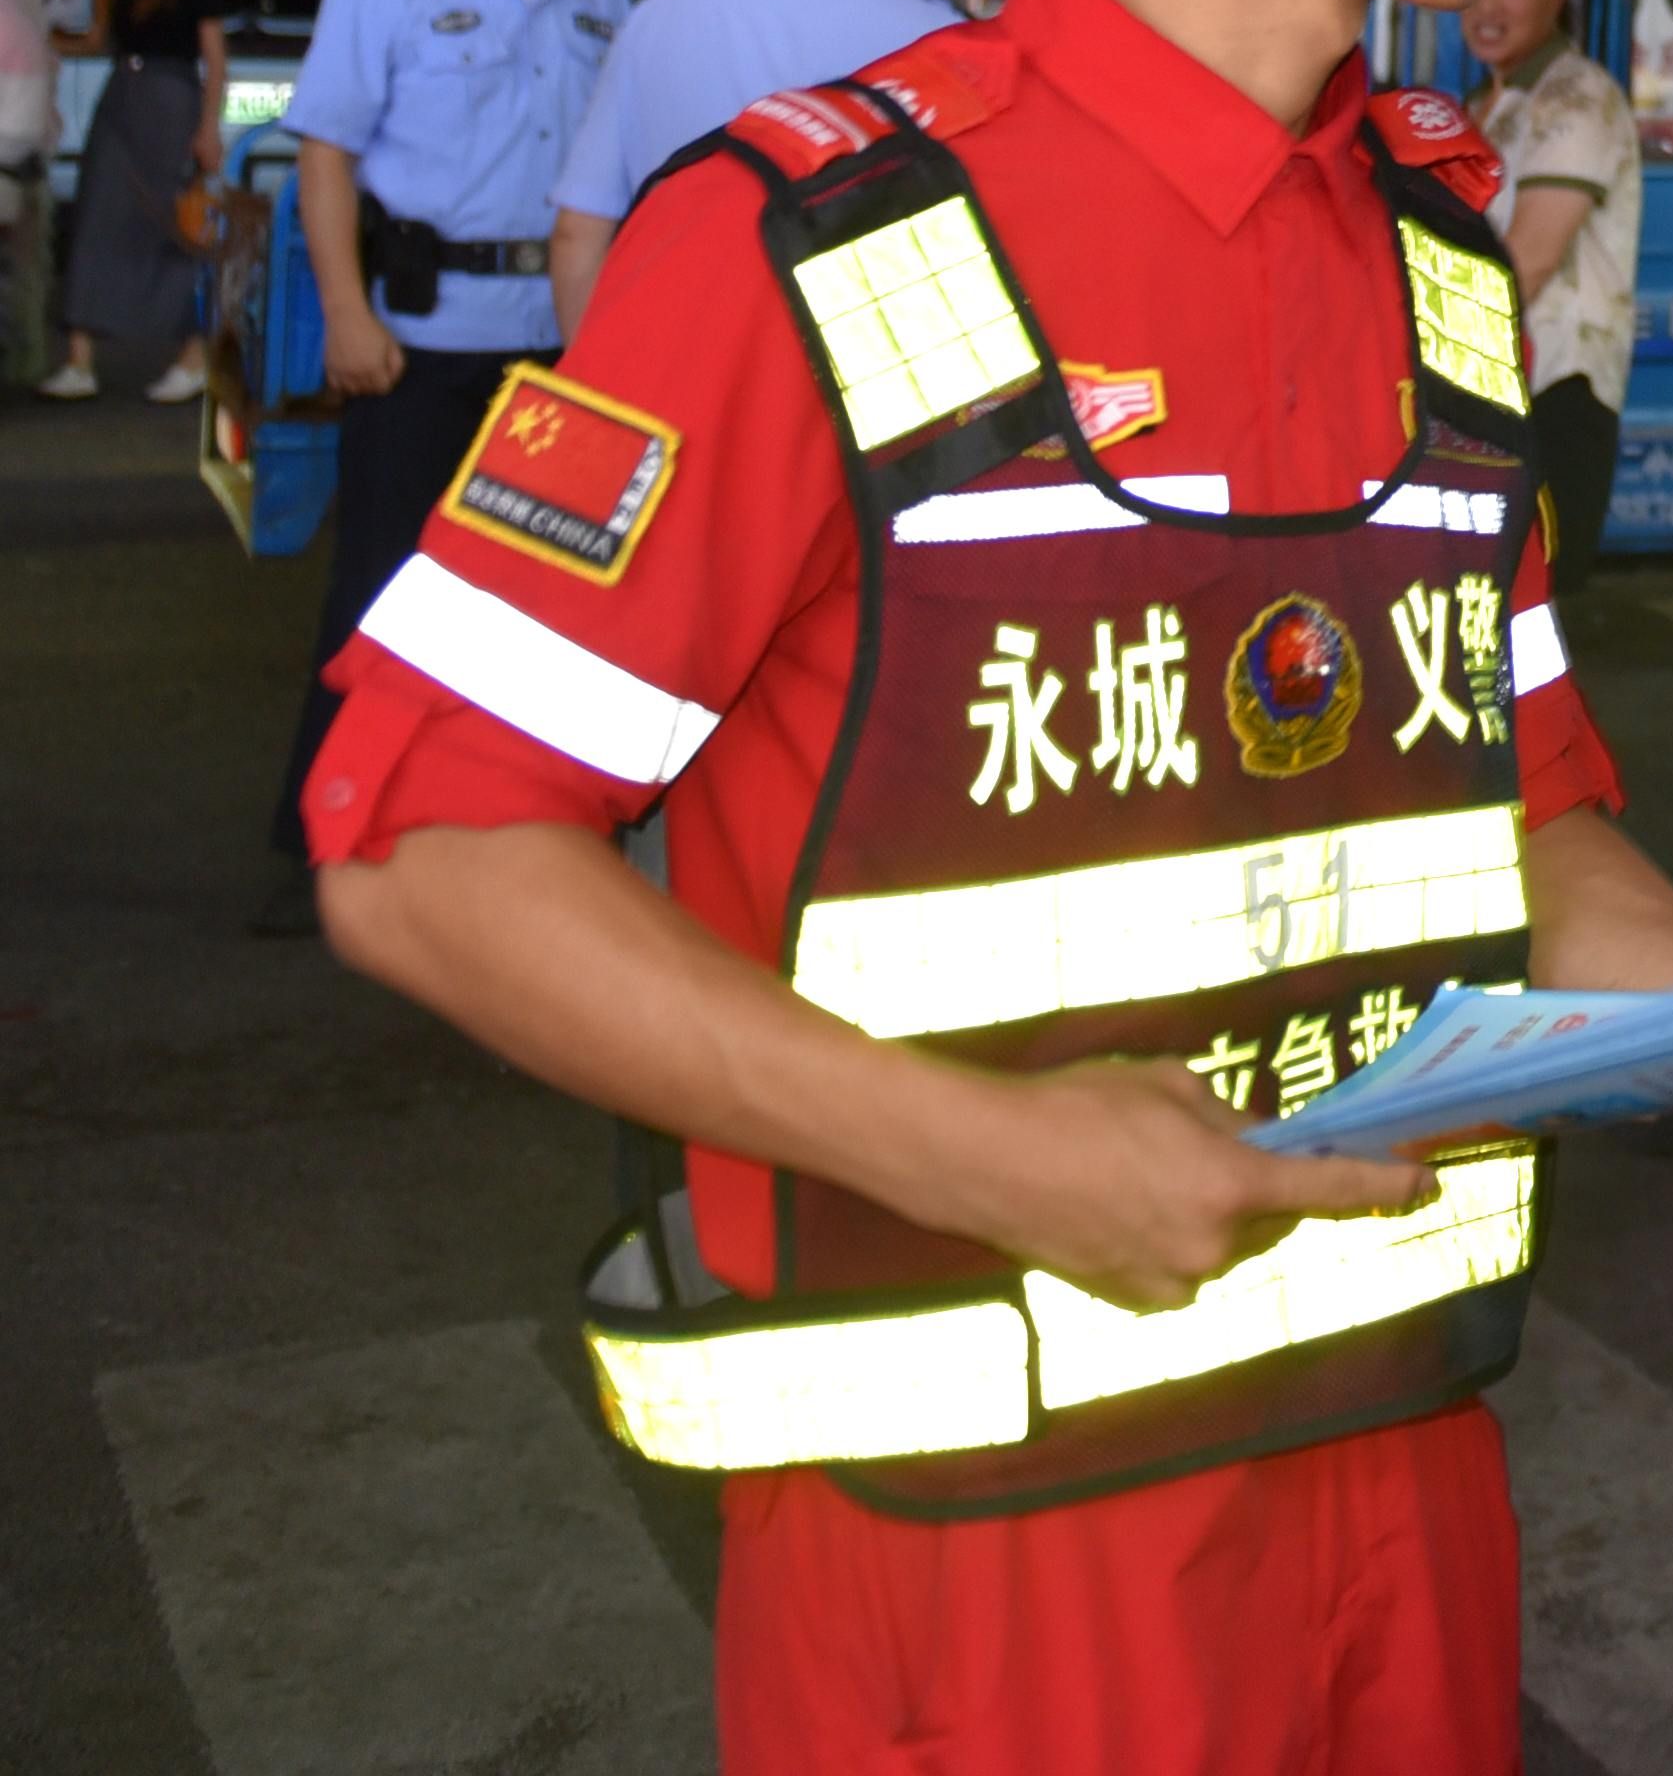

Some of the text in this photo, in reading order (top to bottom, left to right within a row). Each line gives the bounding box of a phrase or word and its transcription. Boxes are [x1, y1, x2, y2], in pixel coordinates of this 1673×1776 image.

[528, 505, 614, 562] CHINA
[968, 572, 1509, 813] 永城 义警
[1244, 840, 1349, 972] 51
